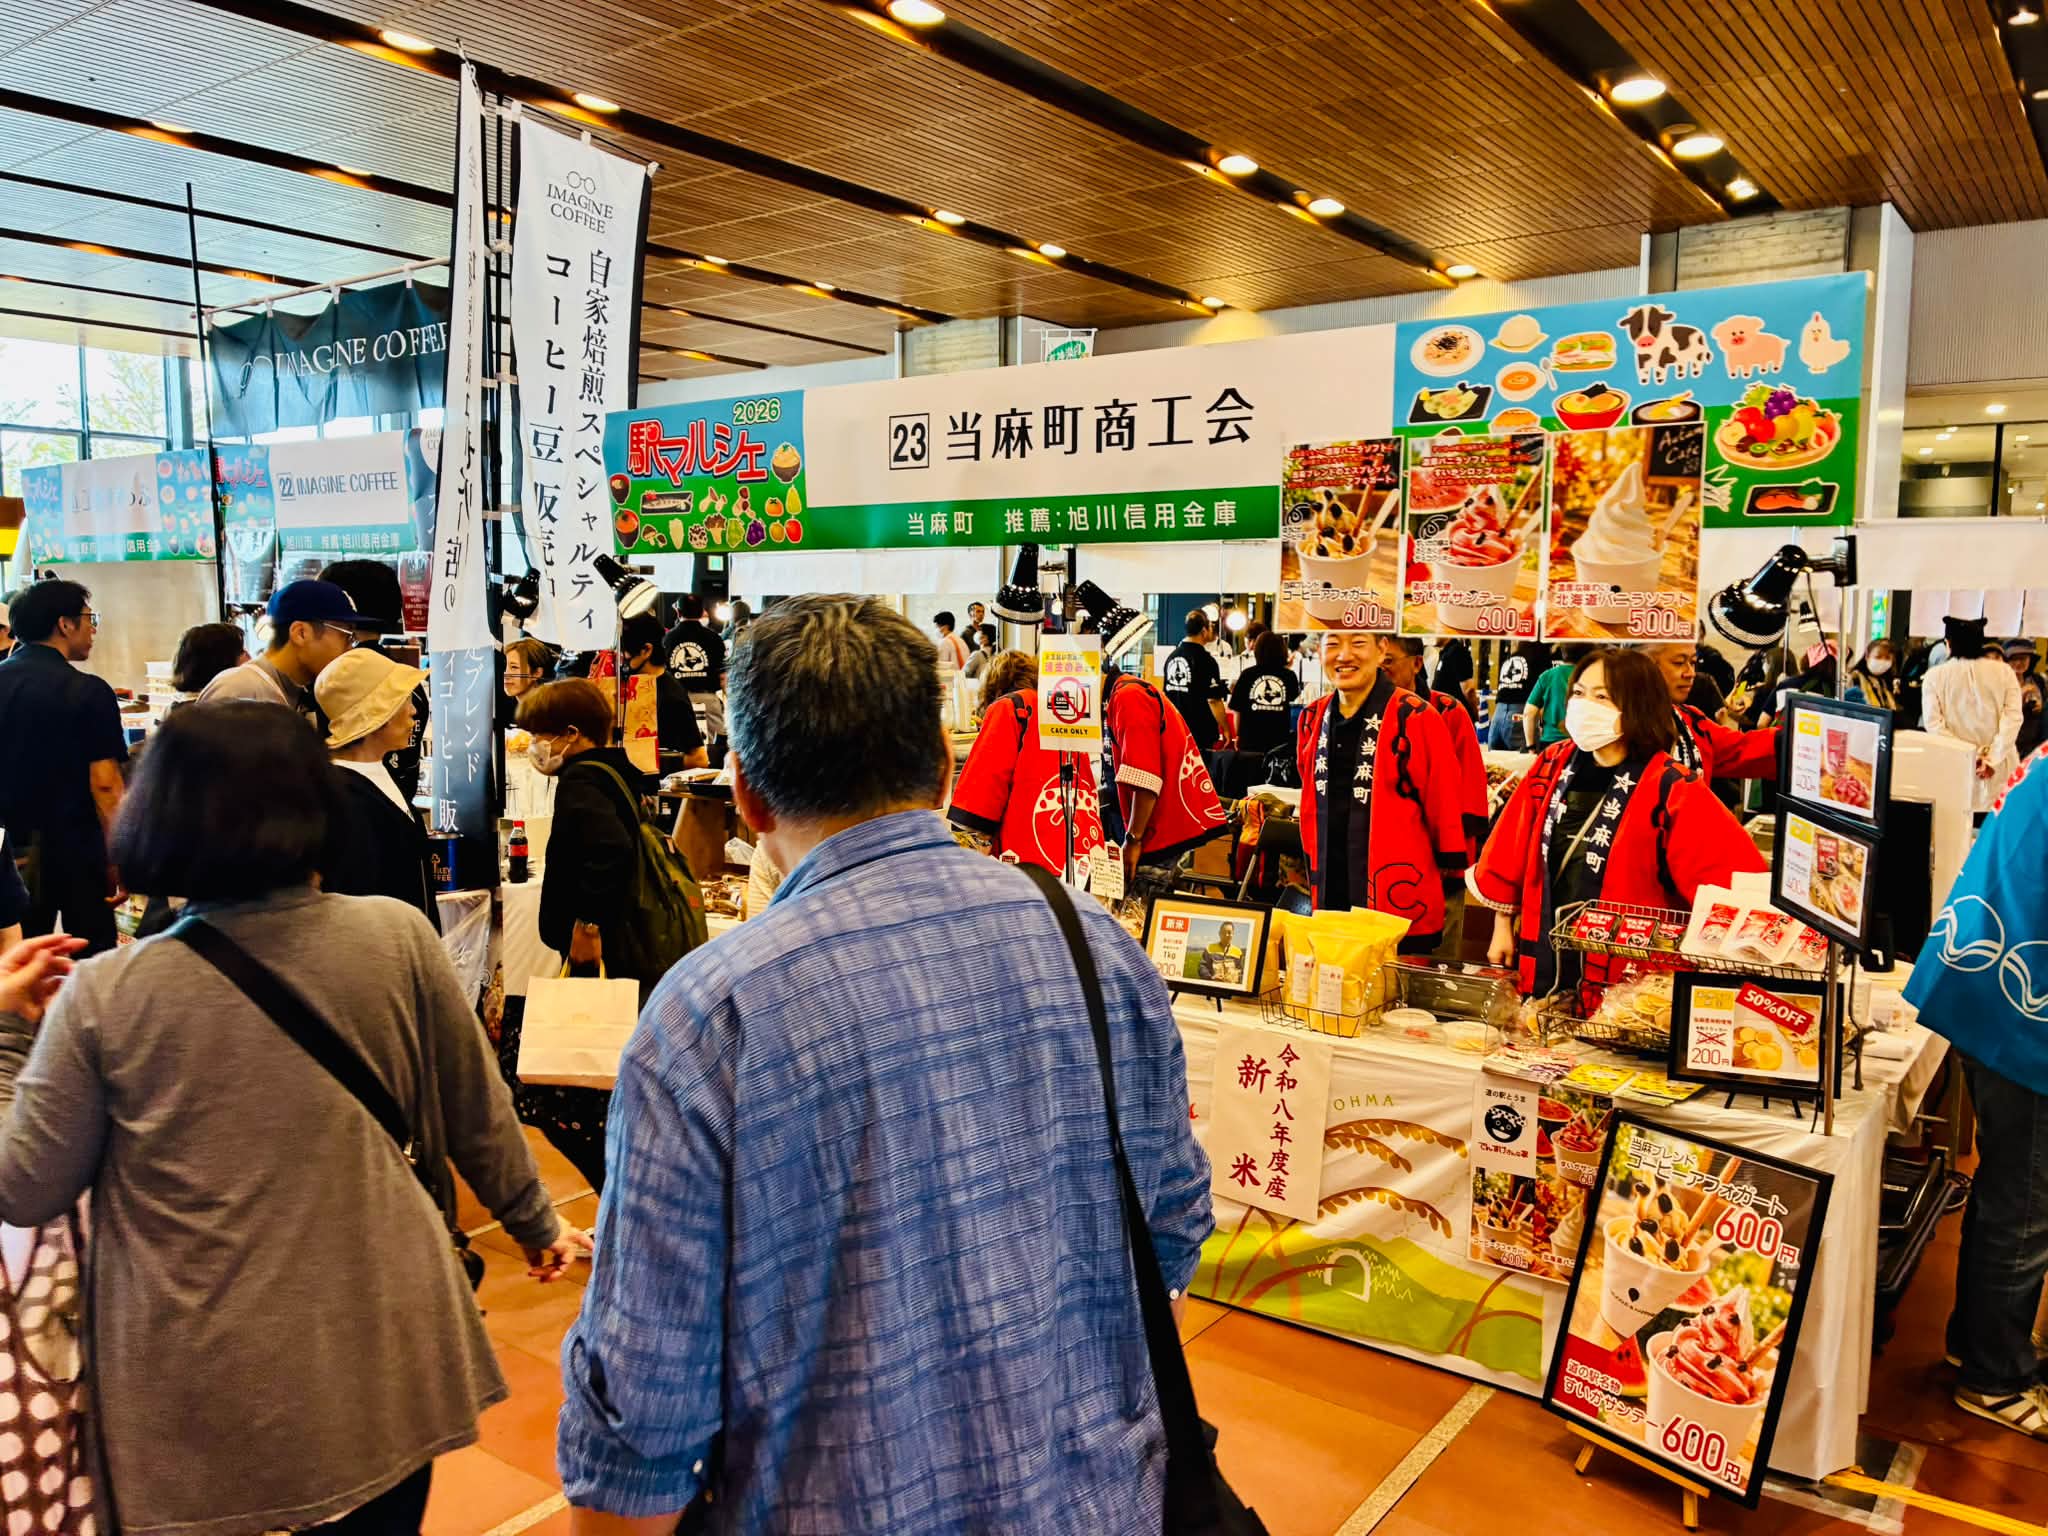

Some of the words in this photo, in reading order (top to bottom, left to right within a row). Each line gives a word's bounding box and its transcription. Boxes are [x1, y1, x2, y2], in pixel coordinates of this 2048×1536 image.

[546, 183, 614, 219] IMAGINE
[550, 203, 606, 234] COFFEE
[733, 398, 781, 425] 2026
[893, 423, 927, 462] 23
[946, 387, 1255, 462] 当麻町商工会
[568, 249, 612, 631] 自家焙煎スペシャルティ
[627, 419, 768, 487] 駅マルシェ
[279, 477, 293, 497] 22
[296, 475, 347, 495] IMAGINE
[350, 471, 400, 492] COFFEE
[907, 511, 975, 536] 当麻町
[1282, 588, 1380, 602] コーヒーアフォガート
[1412, 591, 1505, 605] すいかサンデー
[1556, 592, 1691, 607] 北海道バニラソフト
[1343, 602, 1392, 627] 600円
[1476, 607, 1532, 632] 600円
[1628, 608, 1691, 636] 500円
[1070, 727, 1088, 735] ONLY
[1353, 737, 1377, 805] 当麻町
[1585, 798, 1622, 874] 当麻町
[1744, 988, 1807, 1027] 50%OFF
[1691, 1047, 1730, 1066] 200円
[1333, 1093, 1396, 1111] OHMA
[1229, 1054, 1272, 1188] 新米
[1264, 1042, 1301, 1201] 令和八年度産
[1631, 1136, 1696, 1167] 当麻ブレンド
[1626, 1152, 1789, 1218] コーヒーアフォガート
[1715, 1207, 1800, 1267] 600円
[1566, 1358, 1622, 1396] 道の駅名物
[1564, 1377, 1659, 1430] すいかサンデー
[1661, 1415, 1742, 1483] 600円
